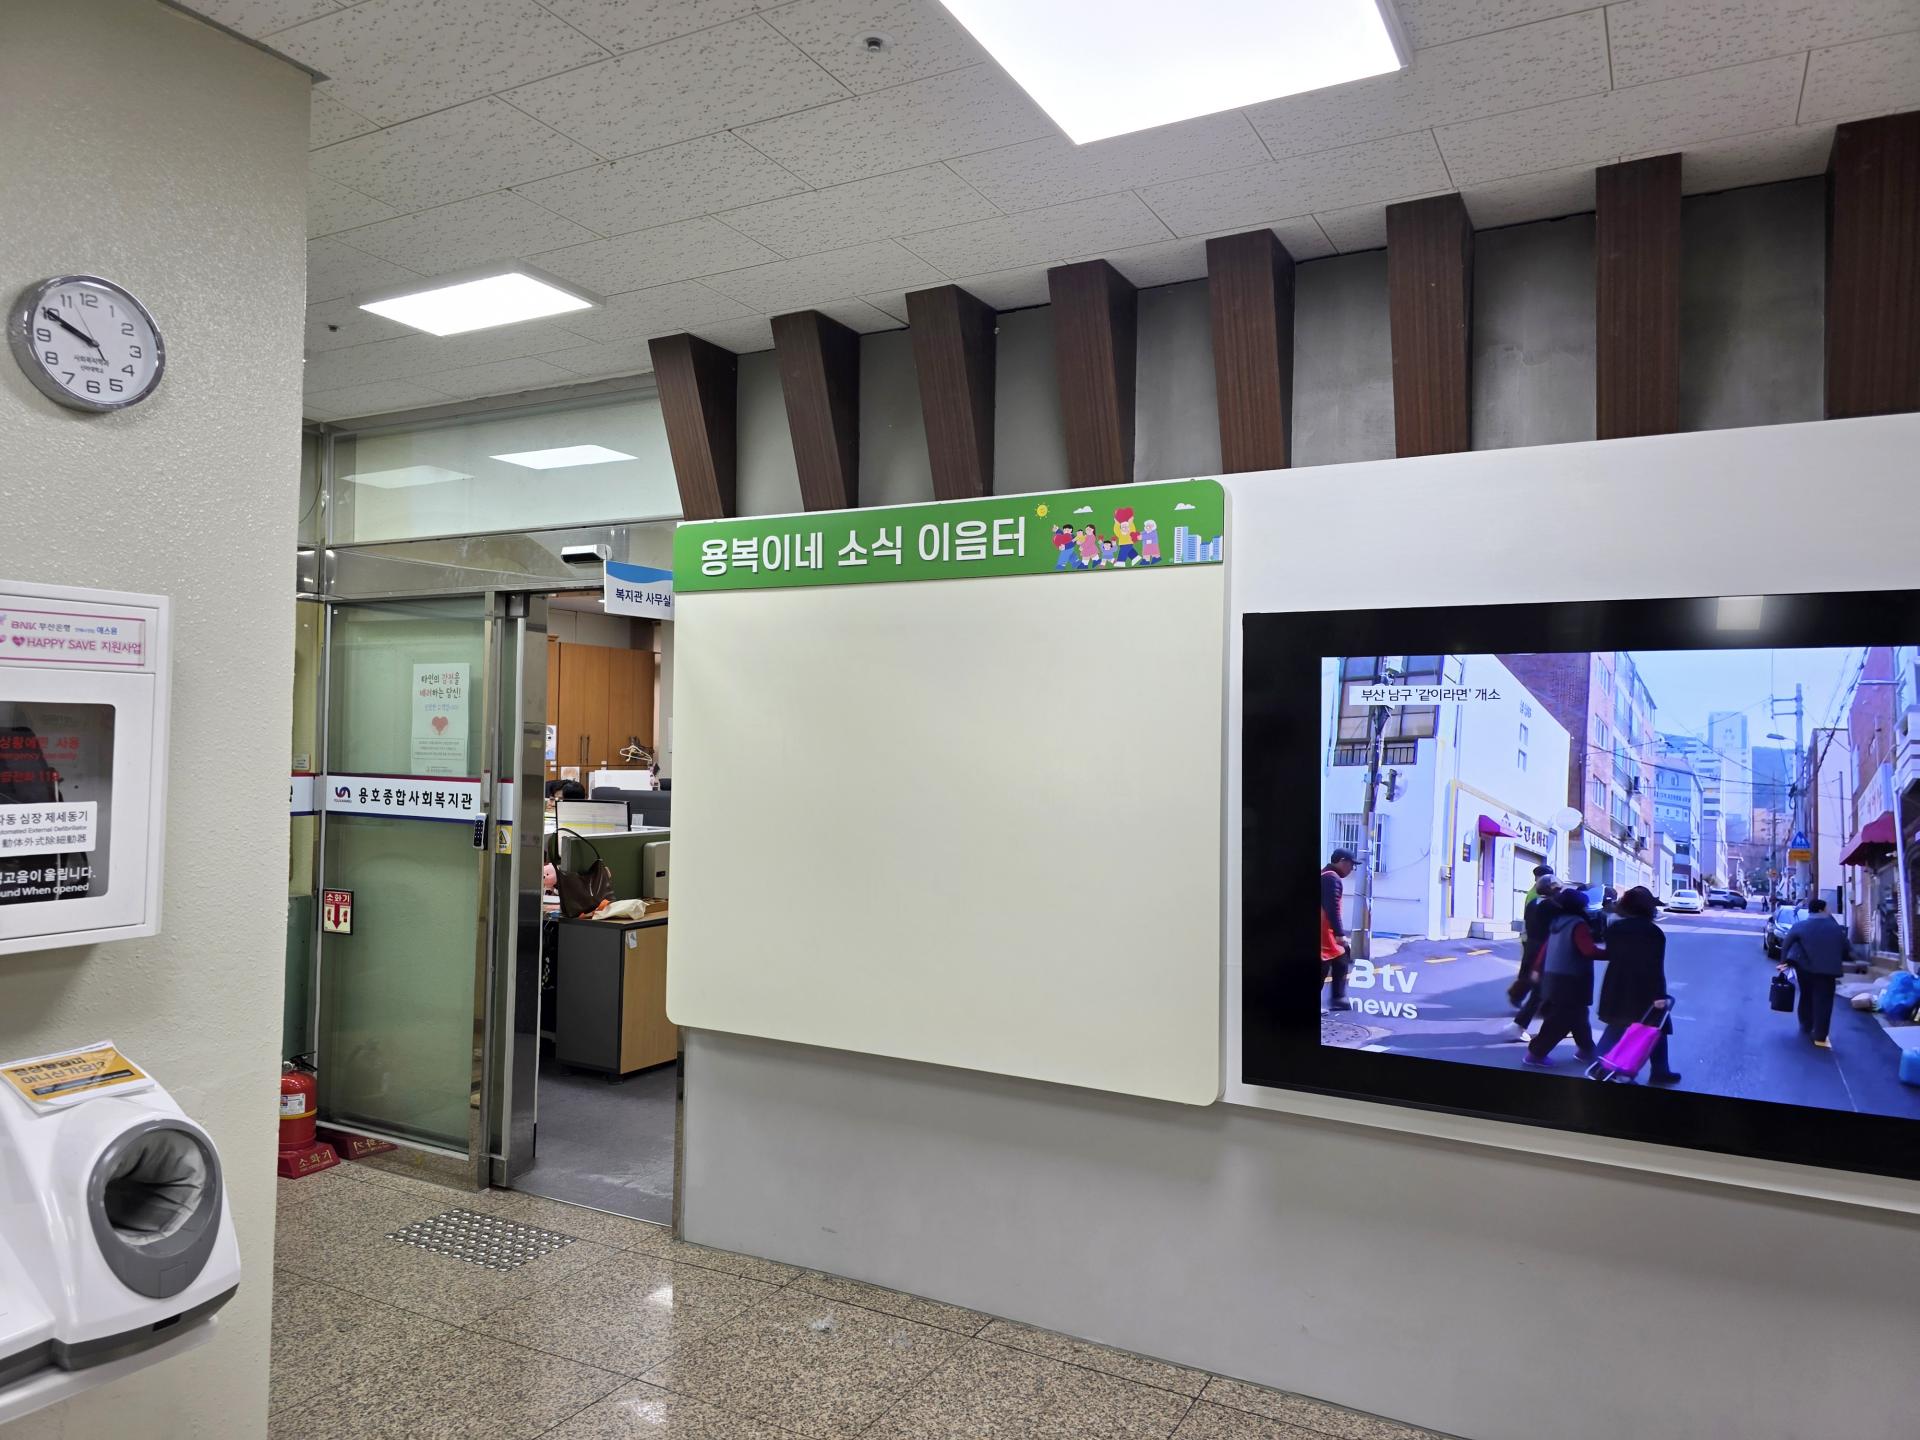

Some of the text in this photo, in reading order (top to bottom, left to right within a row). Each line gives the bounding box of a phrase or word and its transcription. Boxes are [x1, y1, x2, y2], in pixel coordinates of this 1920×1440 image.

[60, 294, 72, 309] 11
[80, 293, 98, 308] 12
[41, 306, 60, 321] 10
[109, 305, 115, 318] 1
[36, 328, 52, 342] 9
[121, 322, 134, 336] 2
[45, 351, 59, 365] 8
[129, 345, 142, 359] 3
[121, 364, 135, 377] 4
[61, 371, 75, 385] 7
[109, 378, 123, 392] 5
[86, 380, 101, 394] 6
[701, 515, 1026, 577] 용복이네 소식 이음터
[615, 587, 671, 608] 복지관 사무실
[11, 620, 37, 631] BNK
[39, 622, 71, 633] 부산은행
[27, 637, 141, 655] HAPPY SAVE 지원사업
[1360, 688, 1502, 702] 부산 남구 '같이라면' 개소
[358, 786, 473, 810] 용호종합사회복지관
[20, 811, 42, 825] 심장
[45, 810, 88, 823] 제세동기
[22, 885, 51, 896] When
[53, 882, 89, 895] opened
[326, 893, 350, 902] 소화기
[1348, 958, 1418, 994] B tv
[1348, 996, 1418, 1019] news
[299, 1149, 333, 1169] 소화기
